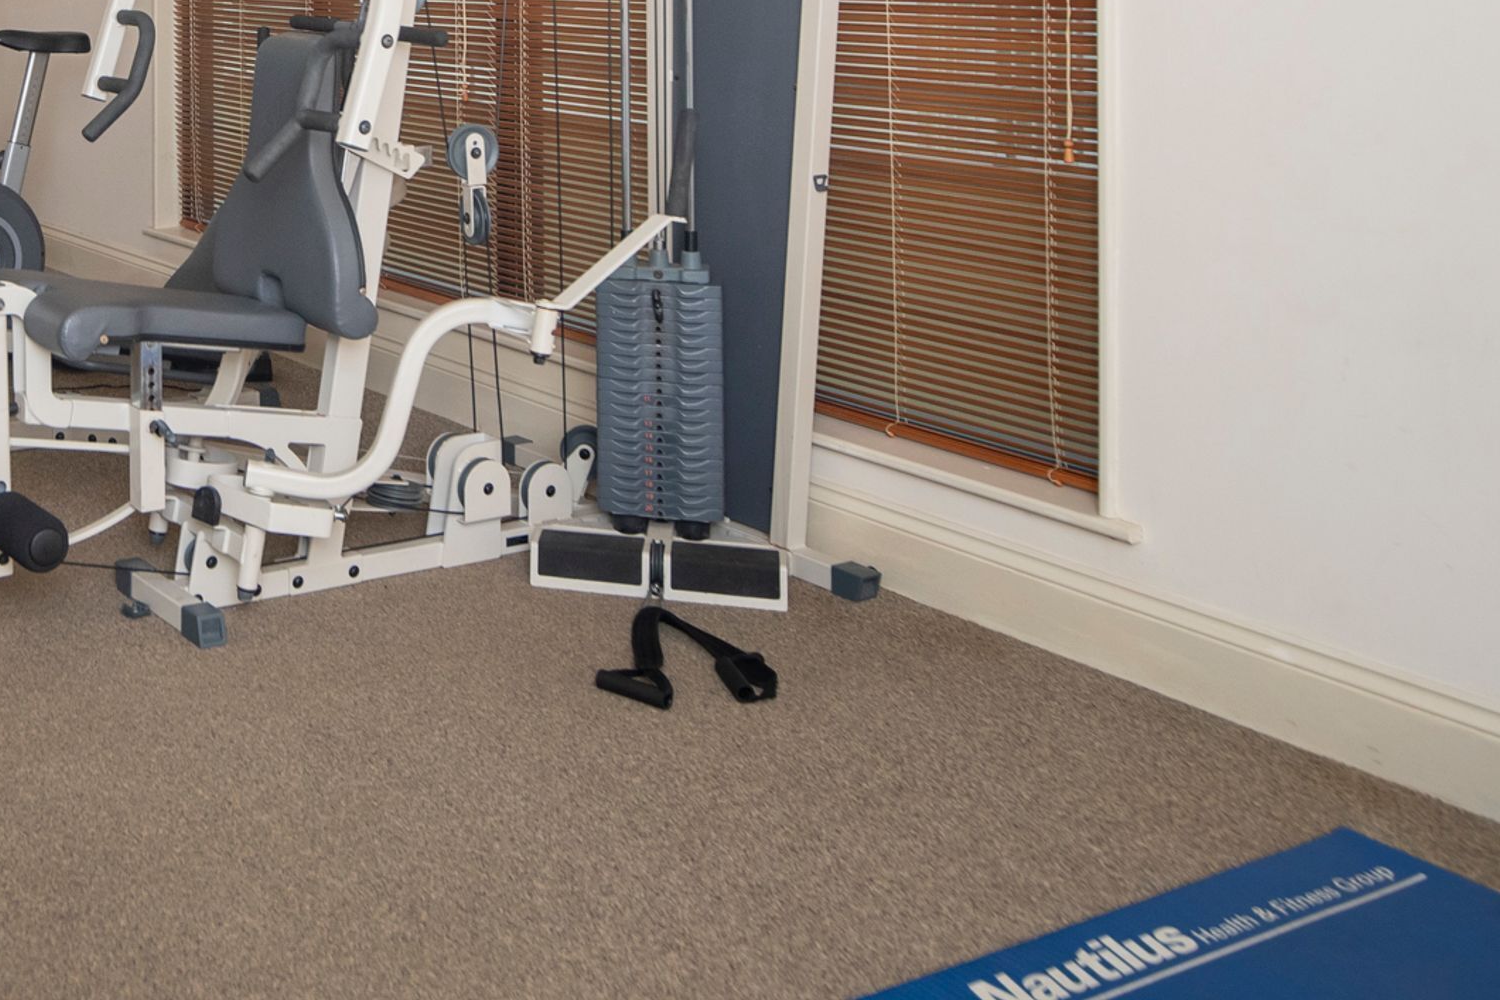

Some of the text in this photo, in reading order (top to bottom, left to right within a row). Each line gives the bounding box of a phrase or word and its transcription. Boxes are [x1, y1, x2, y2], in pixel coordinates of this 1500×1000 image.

[967, 865, 1396, 1000] Nautilus Health & Fitness Group
